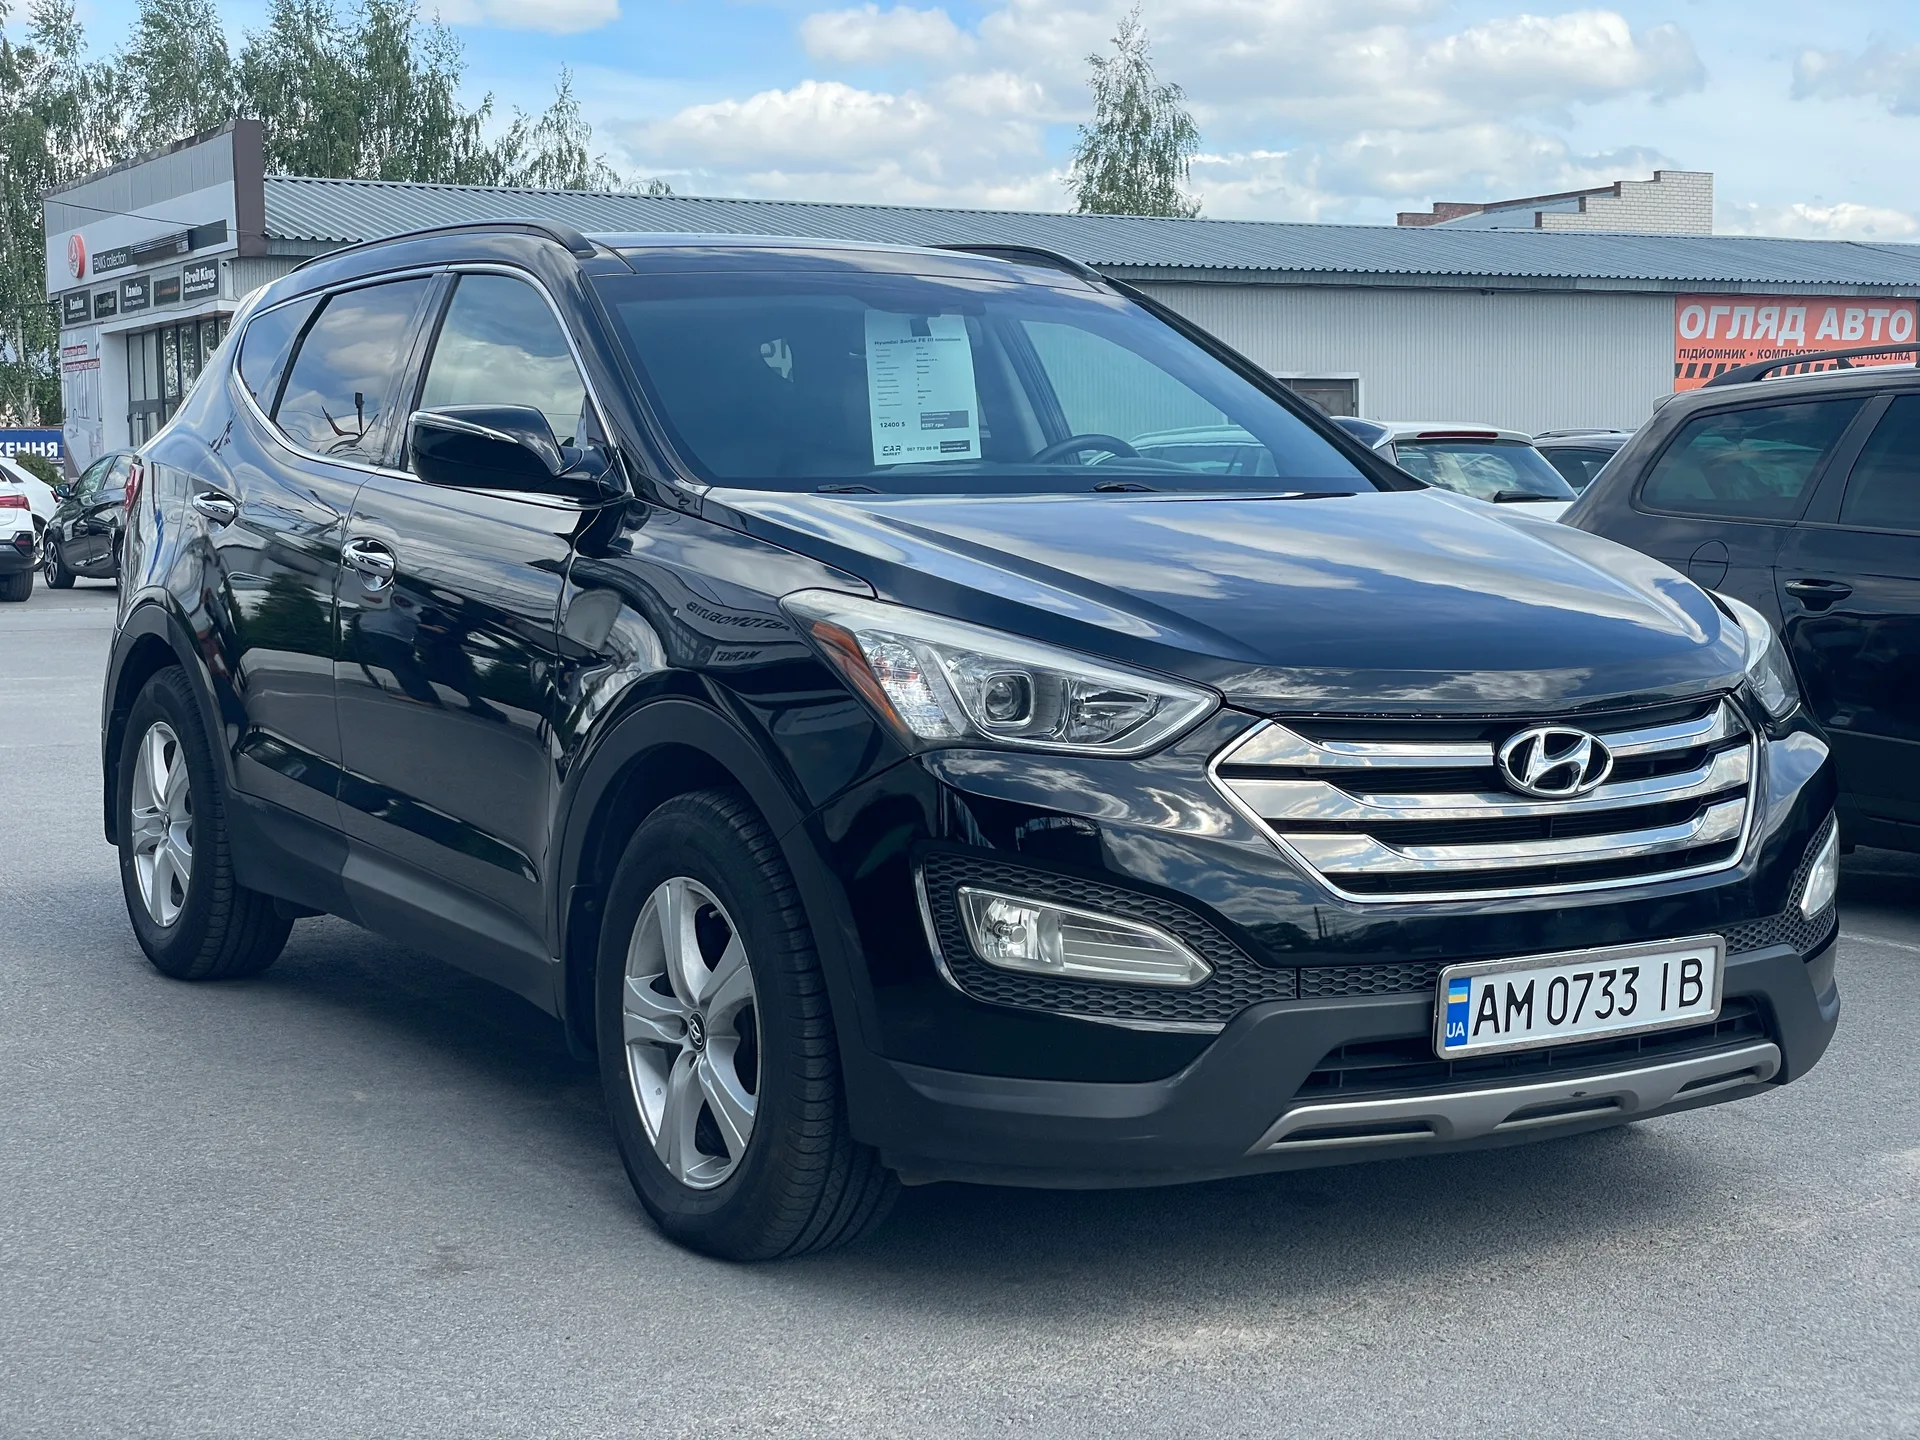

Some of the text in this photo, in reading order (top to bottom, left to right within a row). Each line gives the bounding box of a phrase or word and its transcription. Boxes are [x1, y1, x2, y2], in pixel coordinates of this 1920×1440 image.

[184, 268, 200, 284] Broil
[1678, 304, 1913, 347] ОГЛЯД АВТО
[1678, 347, 1746, 361] ПІДЙОМНИК
[1472, 957, 1704, 1037] AM 0733 IB
[1446, 1022, 1466, 1039] UA
